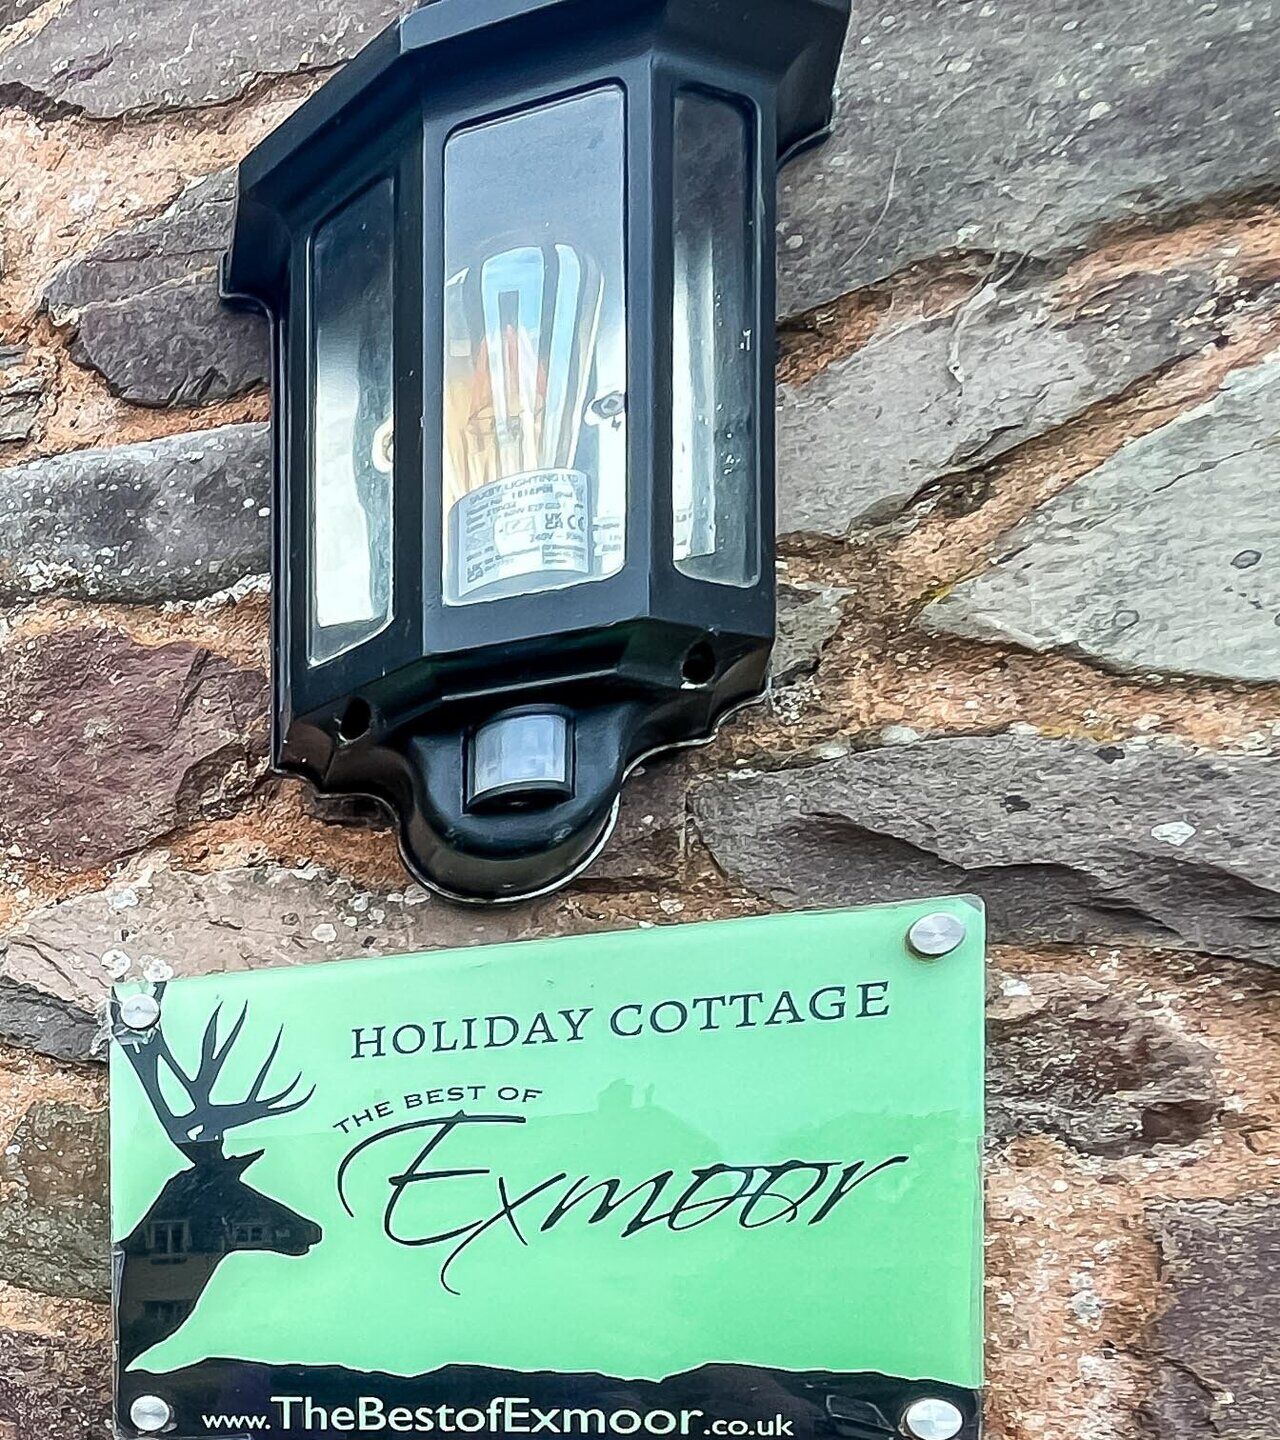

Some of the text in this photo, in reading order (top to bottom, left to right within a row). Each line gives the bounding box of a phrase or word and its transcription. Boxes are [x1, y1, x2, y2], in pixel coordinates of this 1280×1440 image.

[351, 981, 891, 1059] HOLIDAY COTTAGE
[333, 1085, 543, 1134] THE BEST OF
[337, 1110, 909, 1296] Exmoor
[201, 1395, 795, 1437] www.TheBestofExmoor.co.uk
